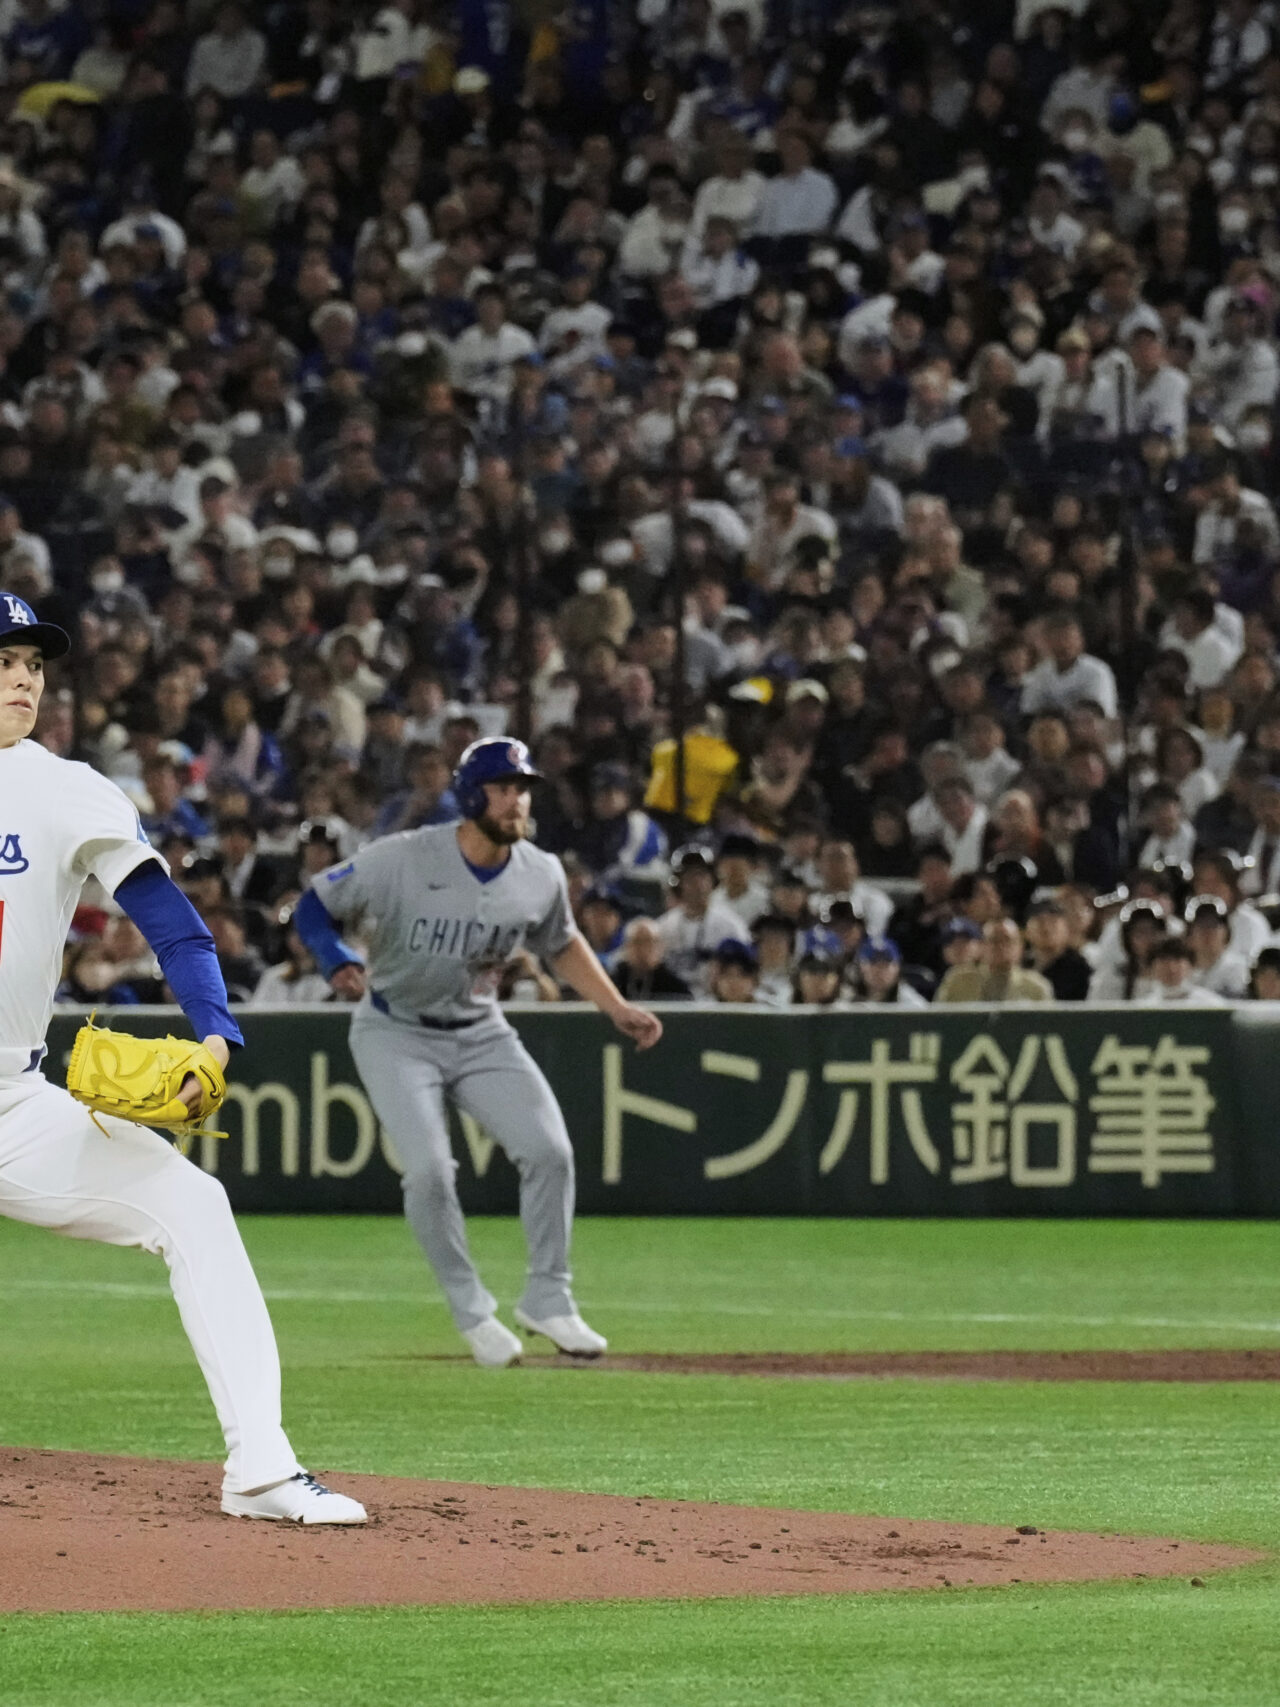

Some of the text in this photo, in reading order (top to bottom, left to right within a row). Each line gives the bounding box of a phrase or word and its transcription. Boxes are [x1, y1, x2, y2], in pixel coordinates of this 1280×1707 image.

[3, 596, 31, 626] LA
[602, 1033, 1216, 1188] トンボ鉛筆
